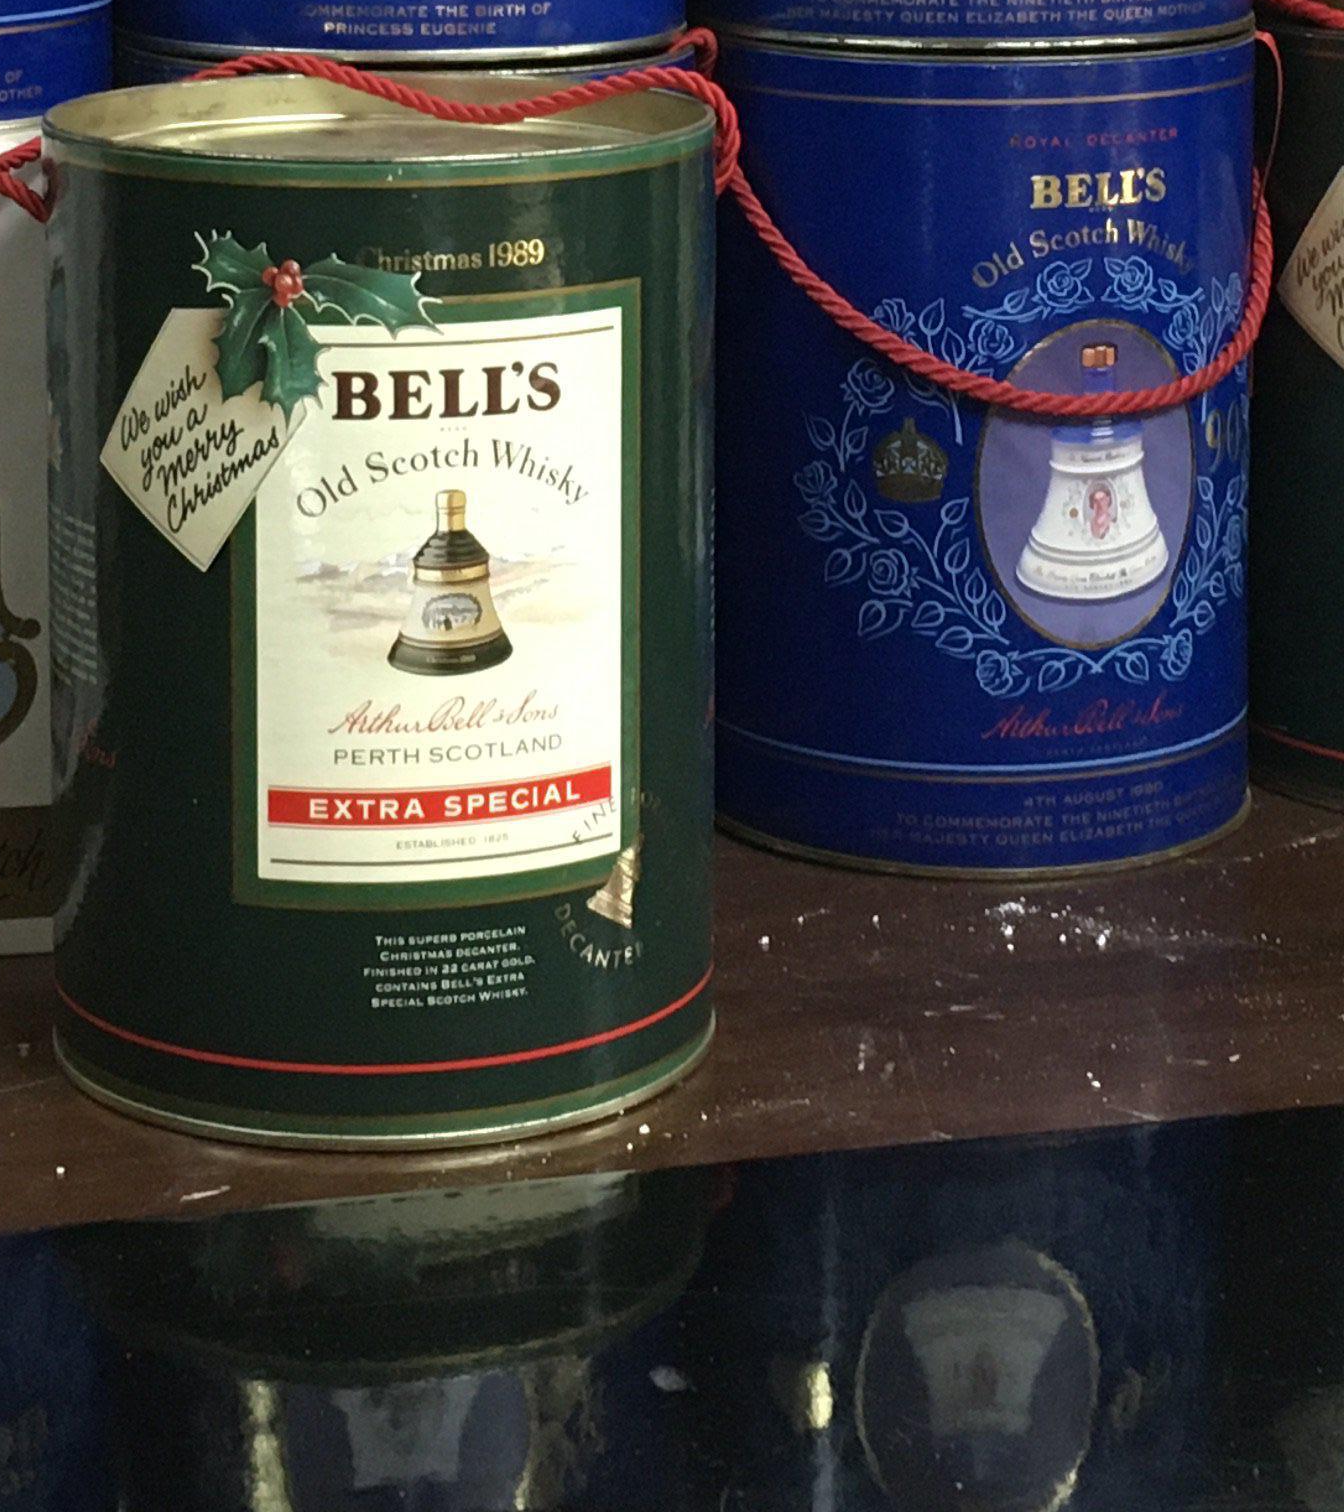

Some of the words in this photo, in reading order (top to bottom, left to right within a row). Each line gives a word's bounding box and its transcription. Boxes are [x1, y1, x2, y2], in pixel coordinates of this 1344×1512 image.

[1030, 167, 1167, 210] BELL'S
[488, 239, 544, 267] 1989
[972, 242, 1024, 288] Old
[1030, 218, 1118, 259] Scotch
[120, 408, 151, 451] We
[154, 364, 207, 421] wish
[331, 362, 562, 421] BELL'S
[141, 426, 184, 491] you
[186, 404, 209, 431] a
[158, 416, 245, 493] Merry
[167, 425, 280, 533] Christmas
[297, 465, 358, 519] Old
[366, 440, 479, 485] Scotch
[491, 439, 589, 505] Whisky
[328, 699, 425, 735] Arthur
[428, 696, 493, 732] Bell
[505, 690, 558, 725] Sons
[334, 748, 419, 766] PERTH
[429, 734, 563, 763] SCOTLAND
[309, 798, 424, 820] EXTRA
[444, 780, 581, 818] SPECIAL
[571, 796, 618, 845] FINE
